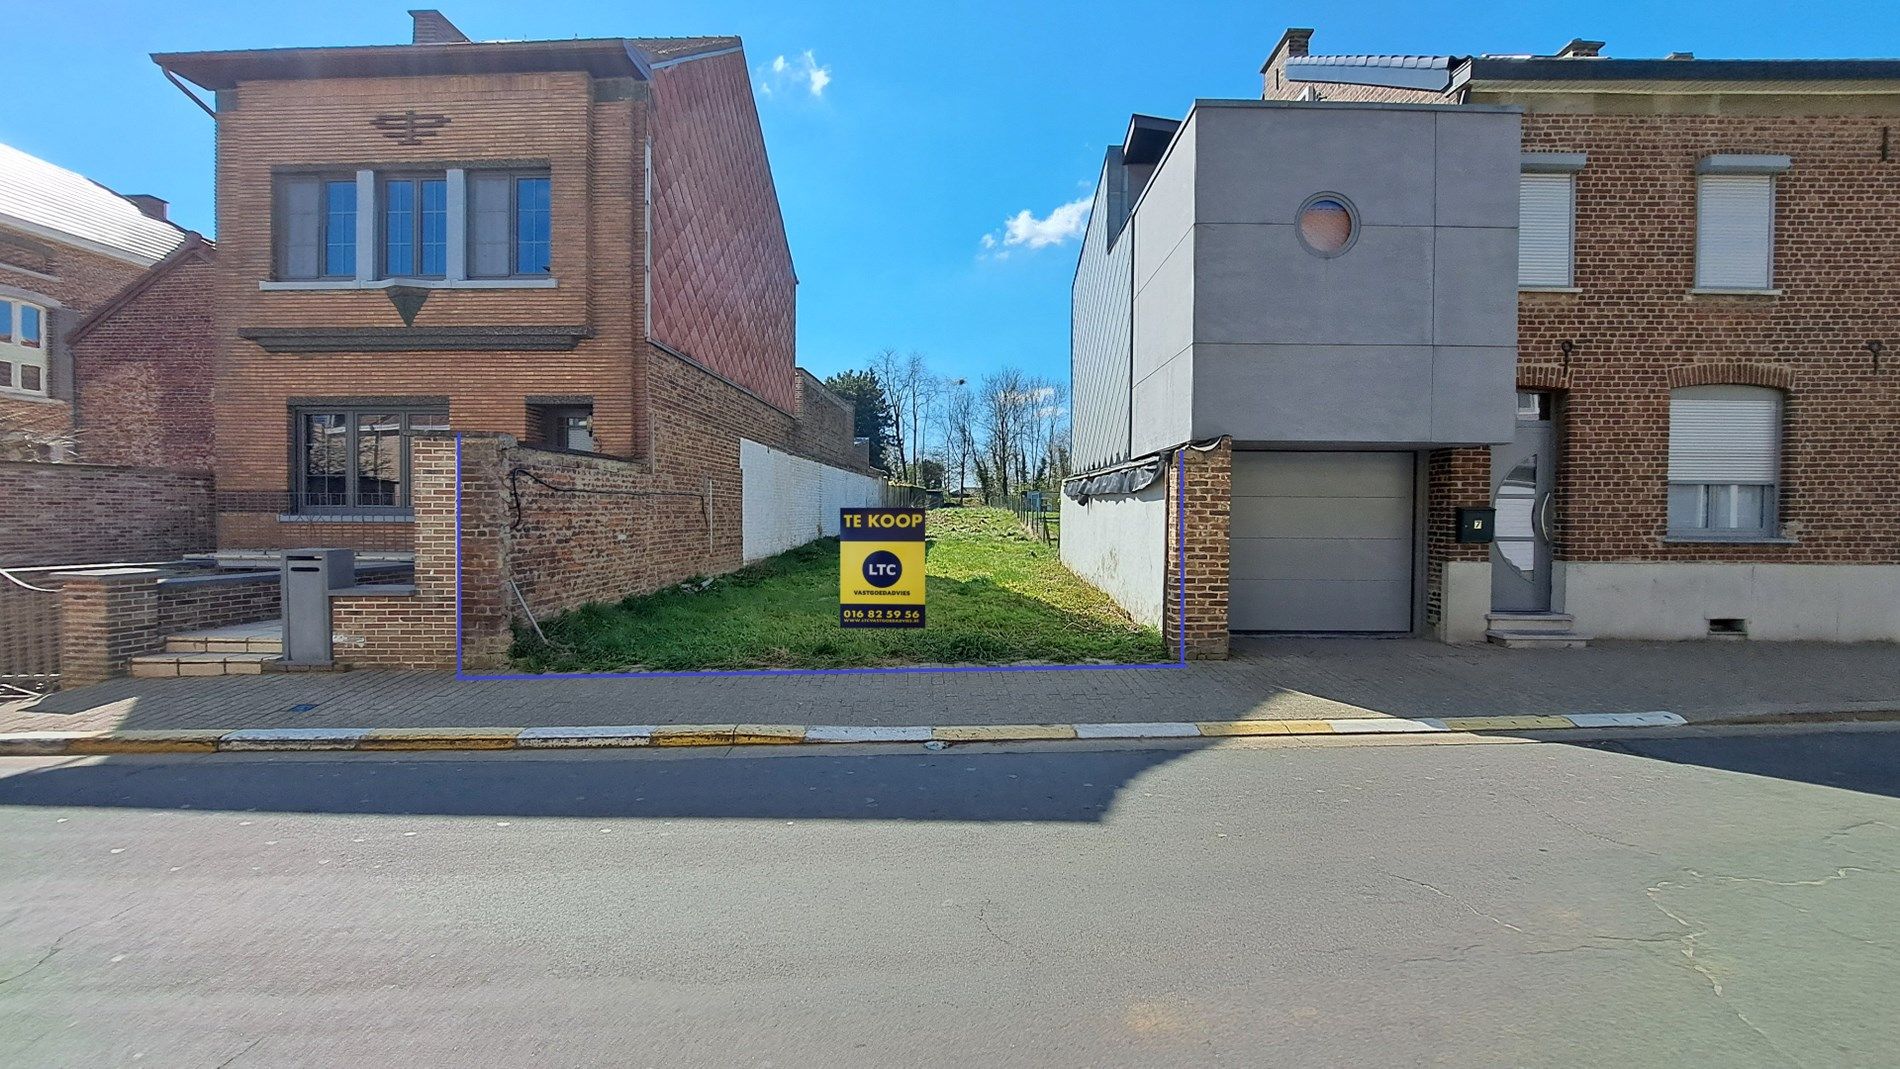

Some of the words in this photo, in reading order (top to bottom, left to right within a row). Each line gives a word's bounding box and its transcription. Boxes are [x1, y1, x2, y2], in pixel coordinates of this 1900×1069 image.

[843, 514, 862, 528] TE
[868, 514, 923, 528] KOOP
[868, 563, 896, 575] LTC
[843, 610, 864, 618] 016
[867, 610, 883, 618] 82
[886, 610, 901, 618] 59
[905, 610, 920, 618] 56
